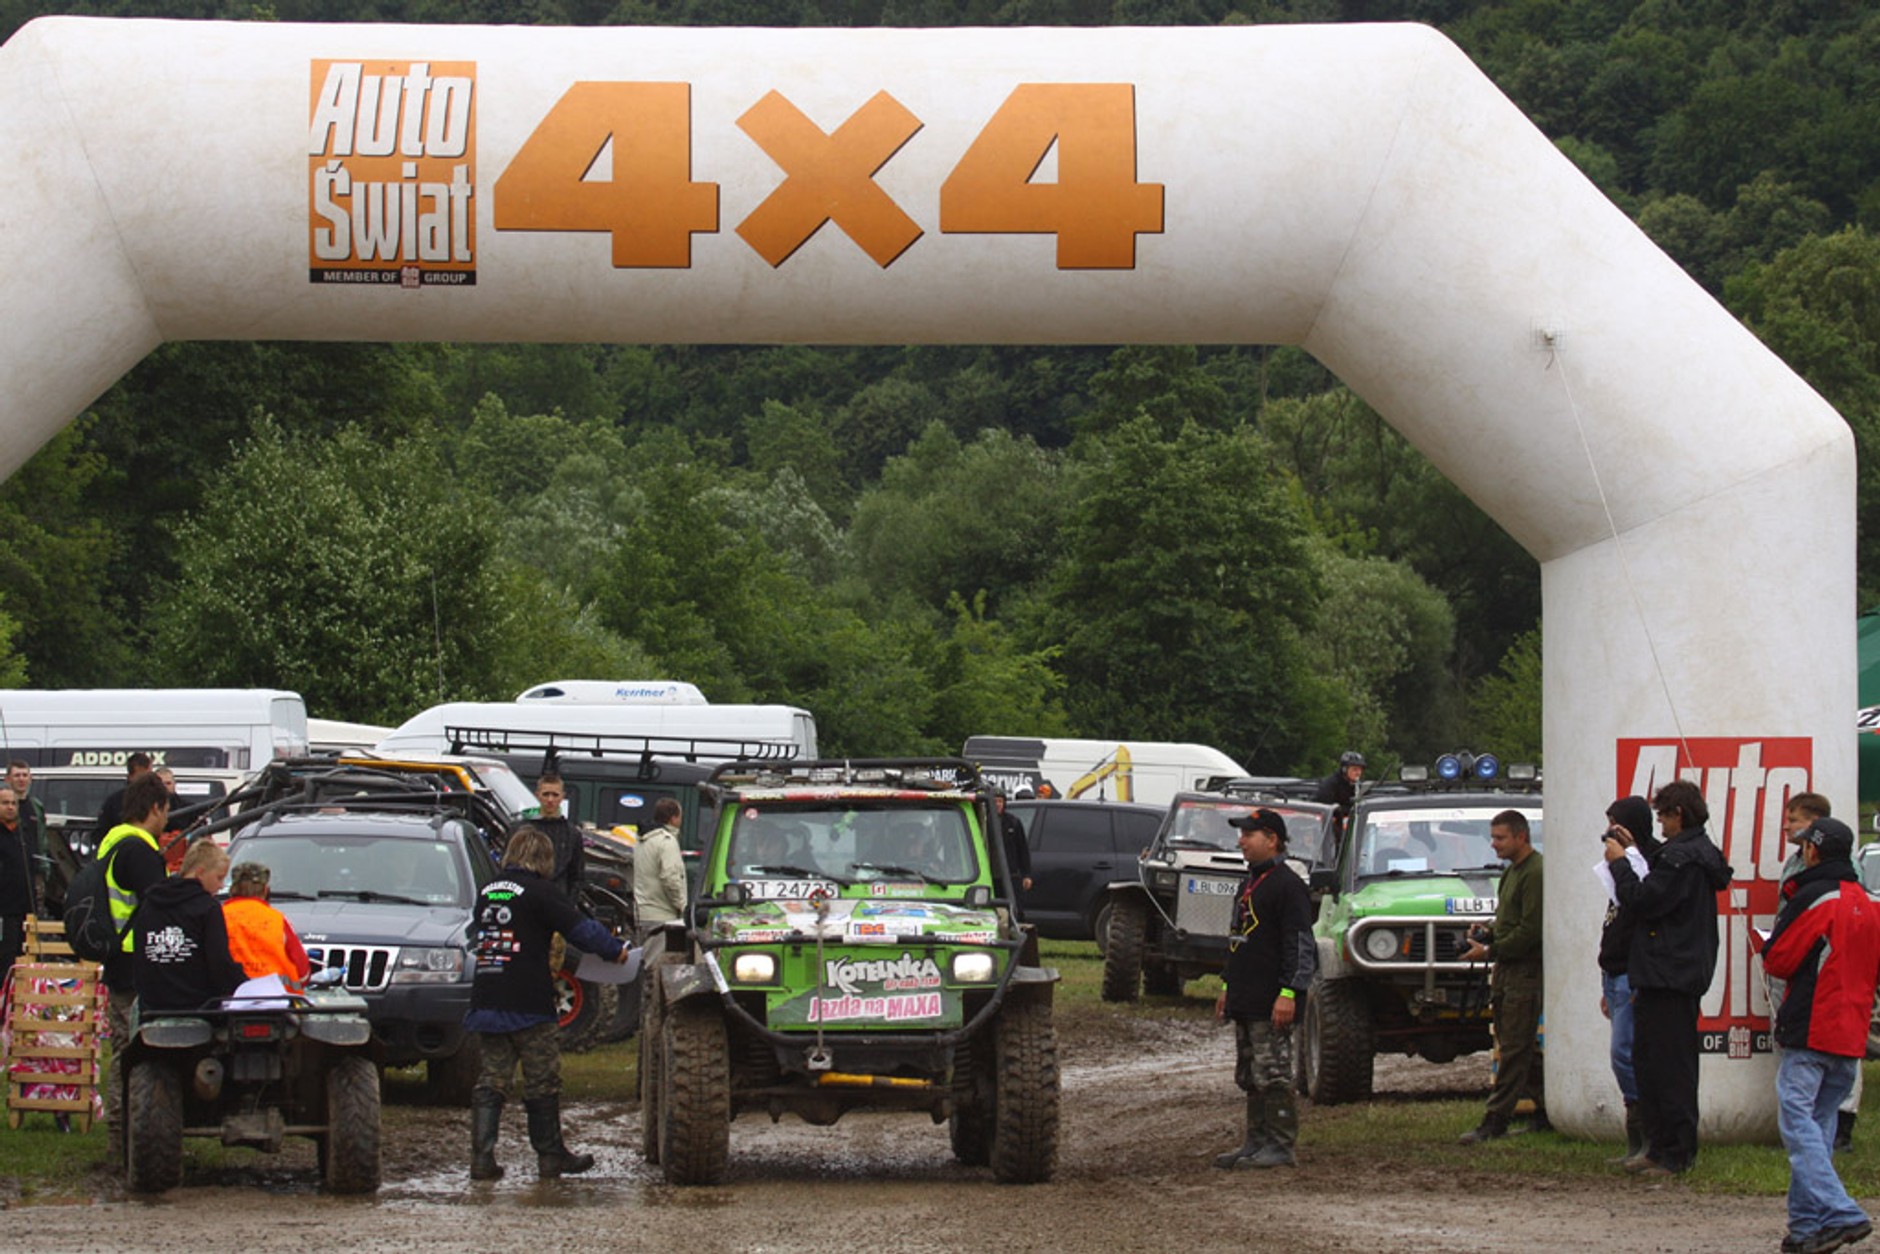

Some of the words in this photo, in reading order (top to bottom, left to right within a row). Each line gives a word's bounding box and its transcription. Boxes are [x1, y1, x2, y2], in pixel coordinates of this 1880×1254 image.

[309, 62, 473, 157] Auto
[493, 81, 1164, 269] 4x4
[313, 160, 473, 262] Świat
[323, 271, 379, 282] MEMBER
[381, 271, 397, 283] OF
[424, 272, 467, 284] GROUP
[864, 997, 885, 1016] na
[886, 993, 940, 1018] MAXA
[1703, 1035, 1723, 1050] OF
